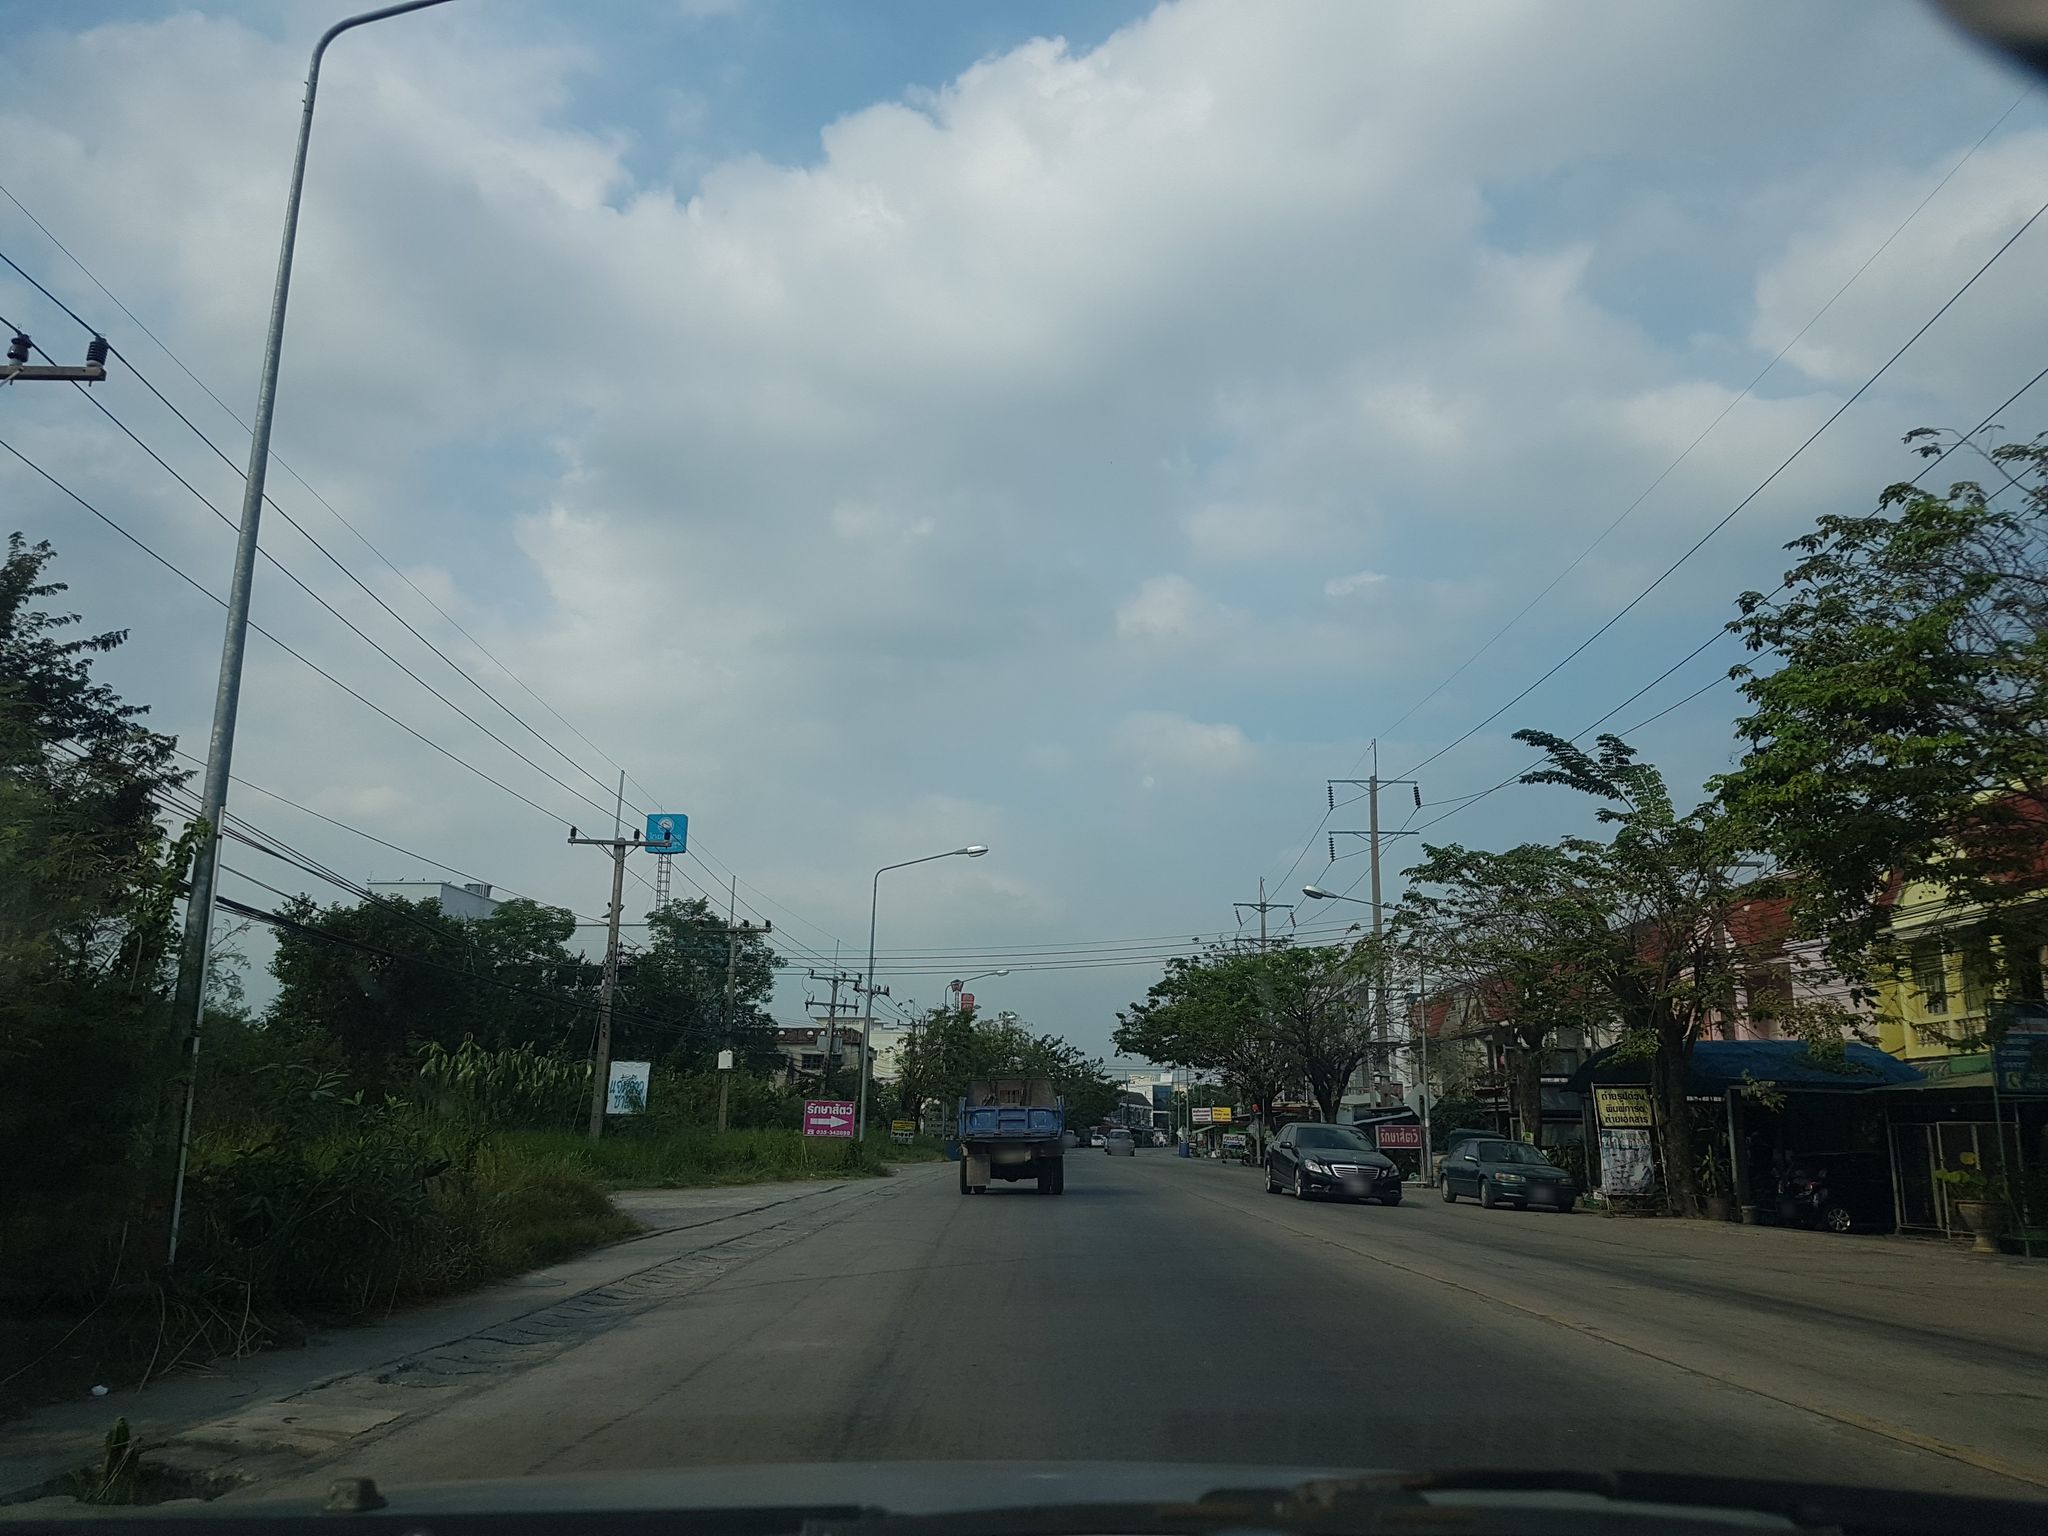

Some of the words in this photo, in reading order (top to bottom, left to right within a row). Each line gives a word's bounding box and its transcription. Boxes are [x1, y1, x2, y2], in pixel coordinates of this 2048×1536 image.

[1601, 1091, 1645, 1102] ถ่ายรูปด่วน
[807, 1103, 853, 1115] รักษาสัตว์
[1605, 1114, 1649, 1123] ถ่ายเอกสาร
